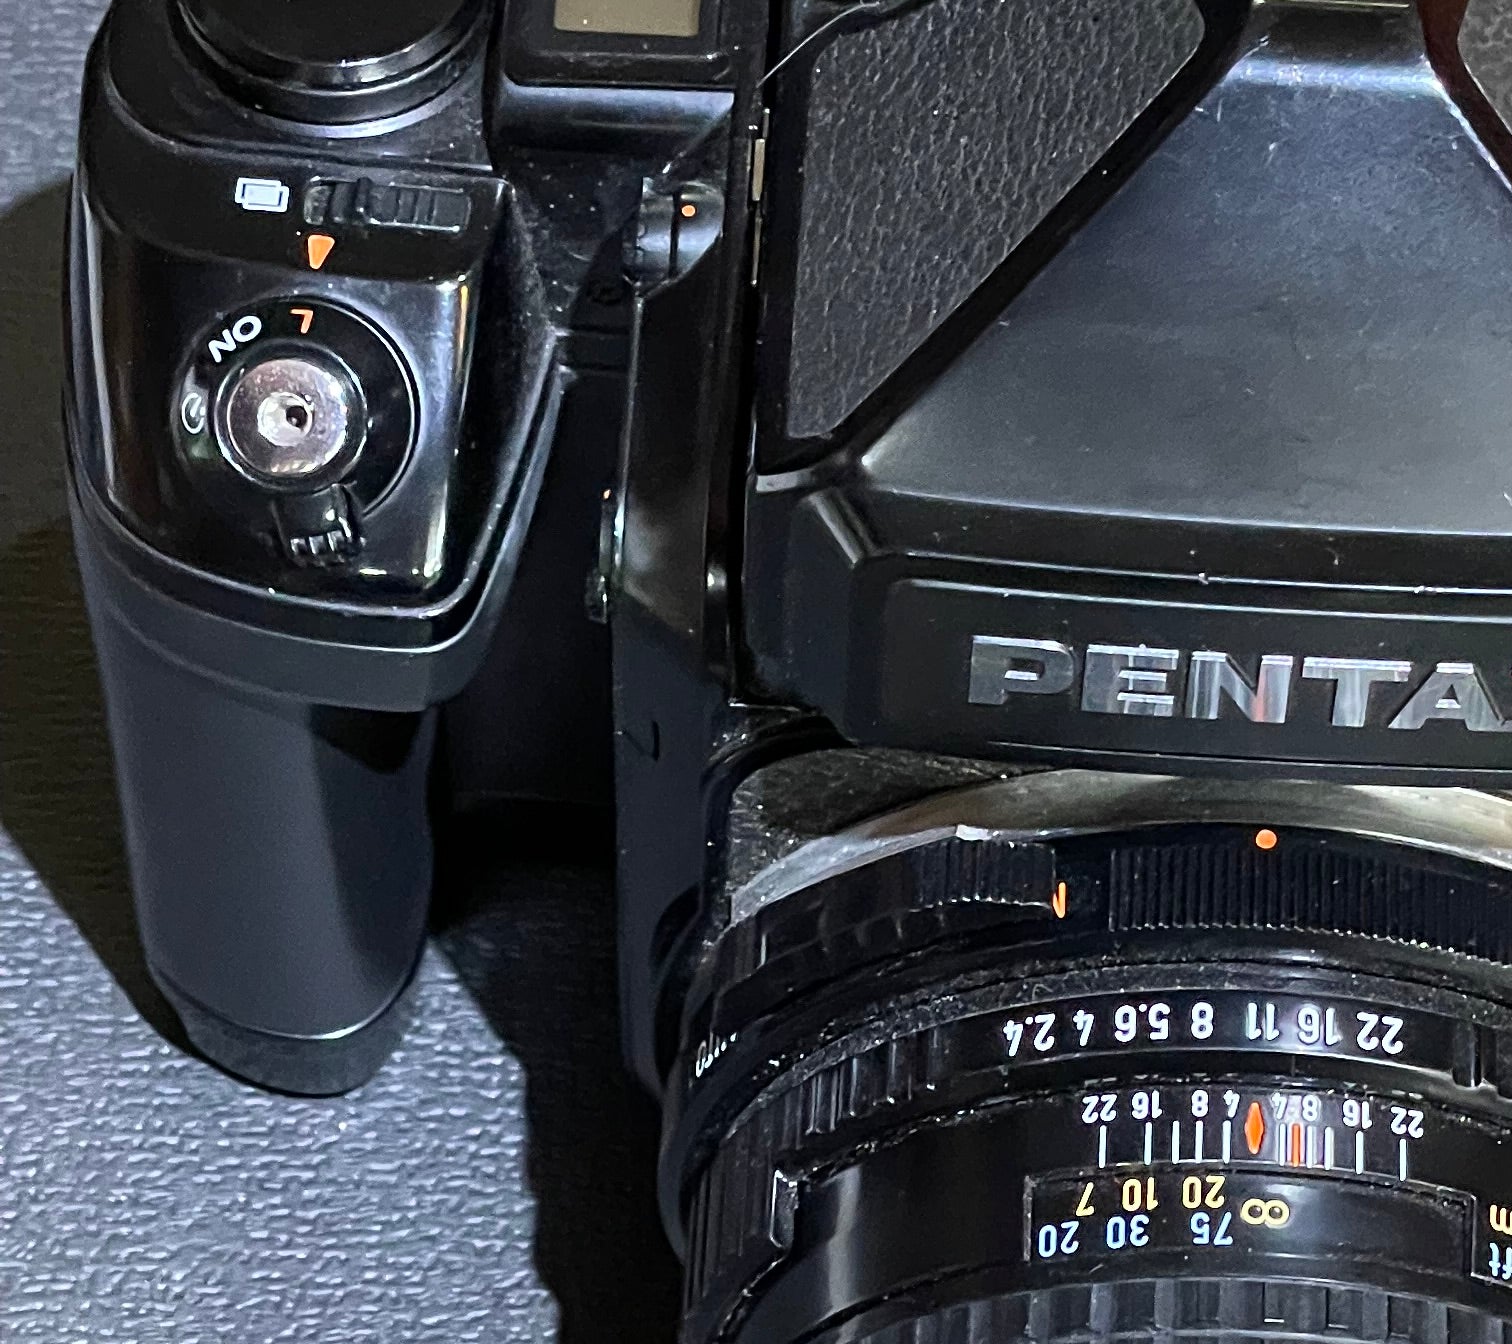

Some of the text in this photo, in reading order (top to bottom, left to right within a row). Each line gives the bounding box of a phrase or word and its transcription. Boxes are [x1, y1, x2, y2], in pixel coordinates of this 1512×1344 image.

[208, 314, 262, 362] ON
[290, 308, 314, 335] L
[1002, 1001, 1405, 1056] 22 16 11 8 5.6 4 2.4
[1081, 1089, 1424, 1139] 22 16 8 4 4 8 16 22
[1075, 1181, 1095, 1217] 7
[1121, 1177, 1157, 1212] 10
[1181, 1175, 1226, 1210] 20
[1039, 1211, 1233, 1258] 75 30 20
